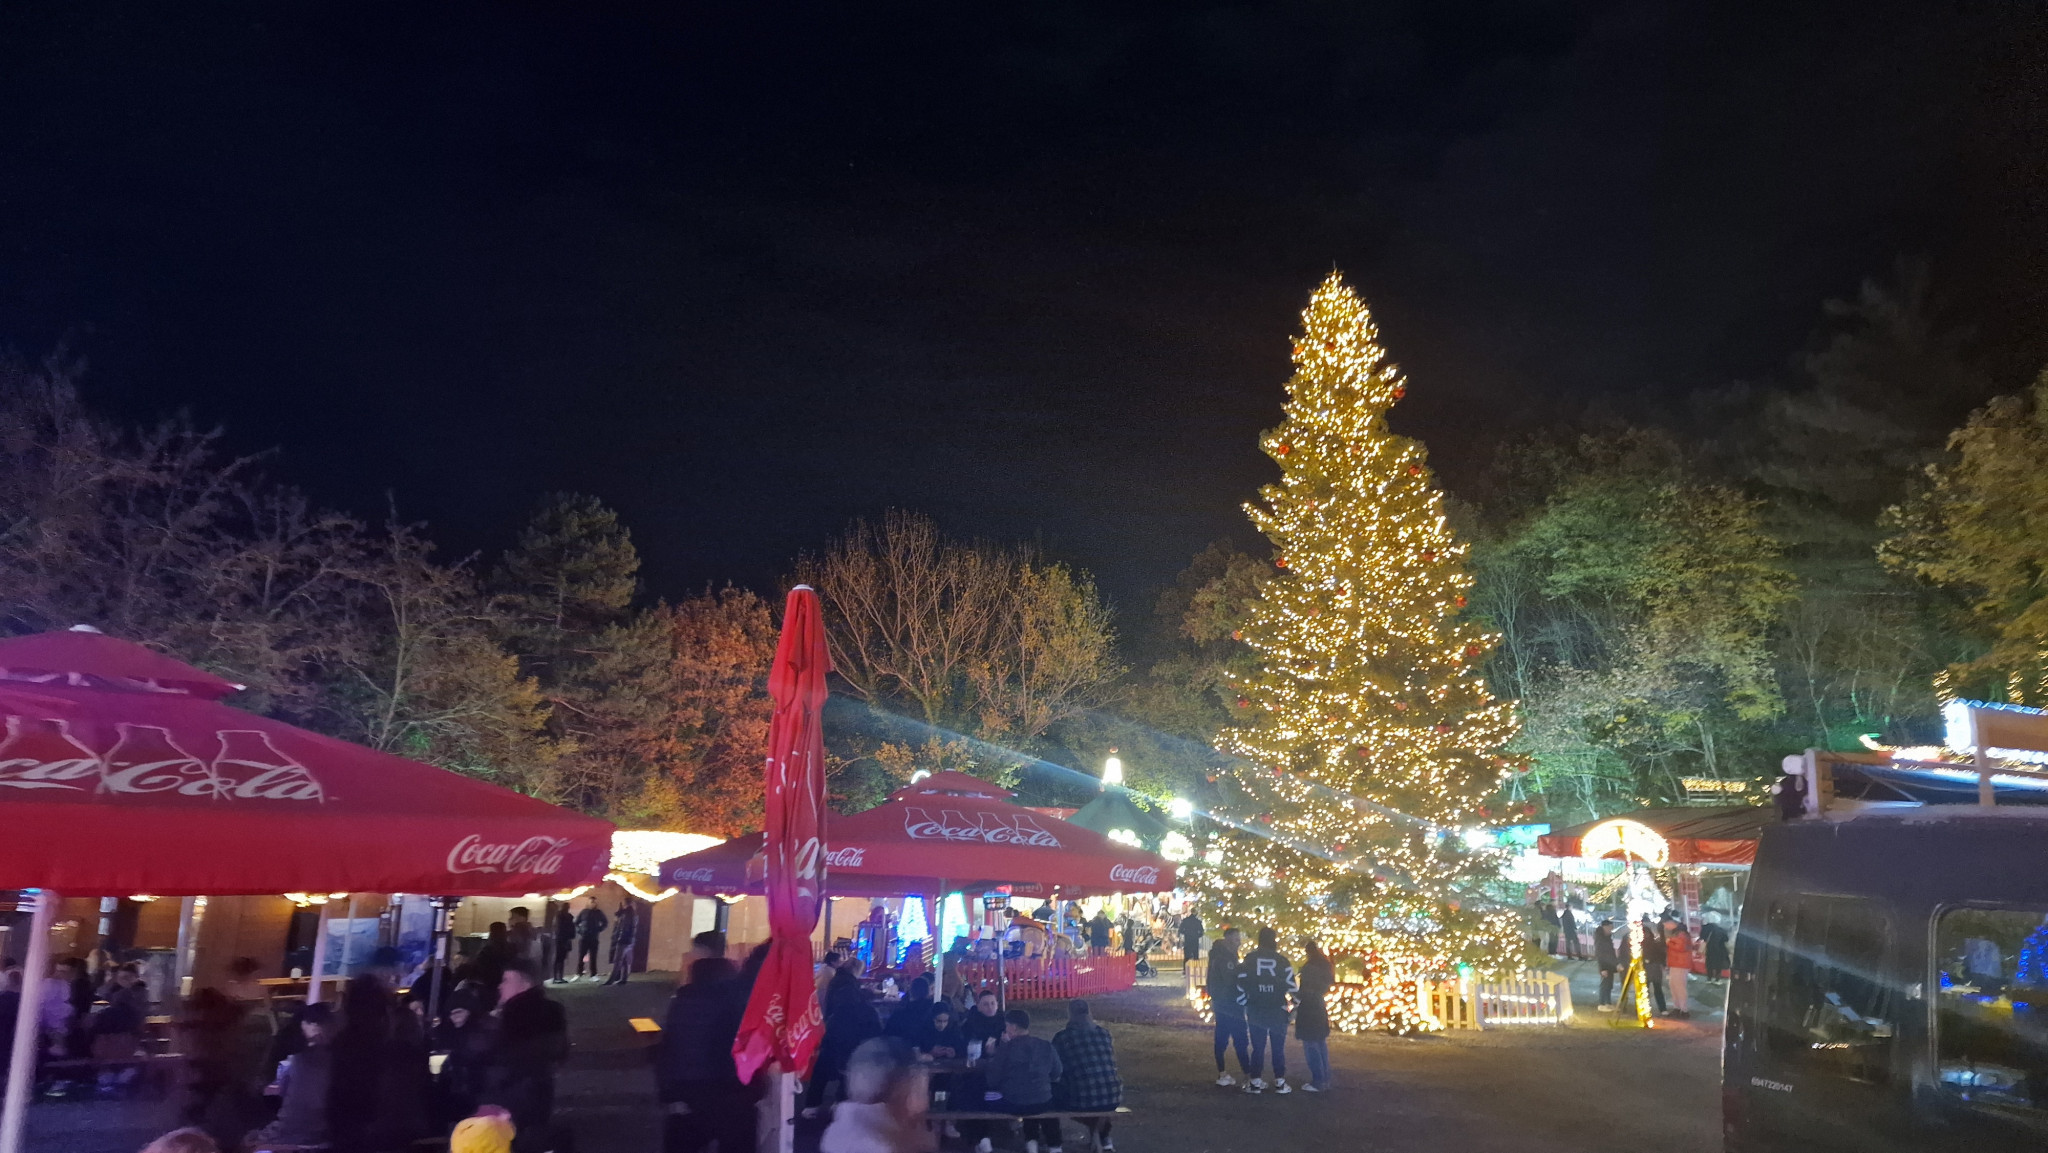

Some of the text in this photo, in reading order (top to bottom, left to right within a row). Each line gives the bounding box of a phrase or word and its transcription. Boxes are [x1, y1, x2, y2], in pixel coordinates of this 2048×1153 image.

[0, 757, 322, 801] ca-Cola
[906, 821, 1061, 848] Coca-Cola
[446, 834, 573, 875] Coca-Cola
[826, 847, 866, 867] a-Cola
[673, 867, 715, 882] Coca-Cola
[1109, 863, 1160, 885] Coca-Cola
[1256, 958, 1277, 977] R
